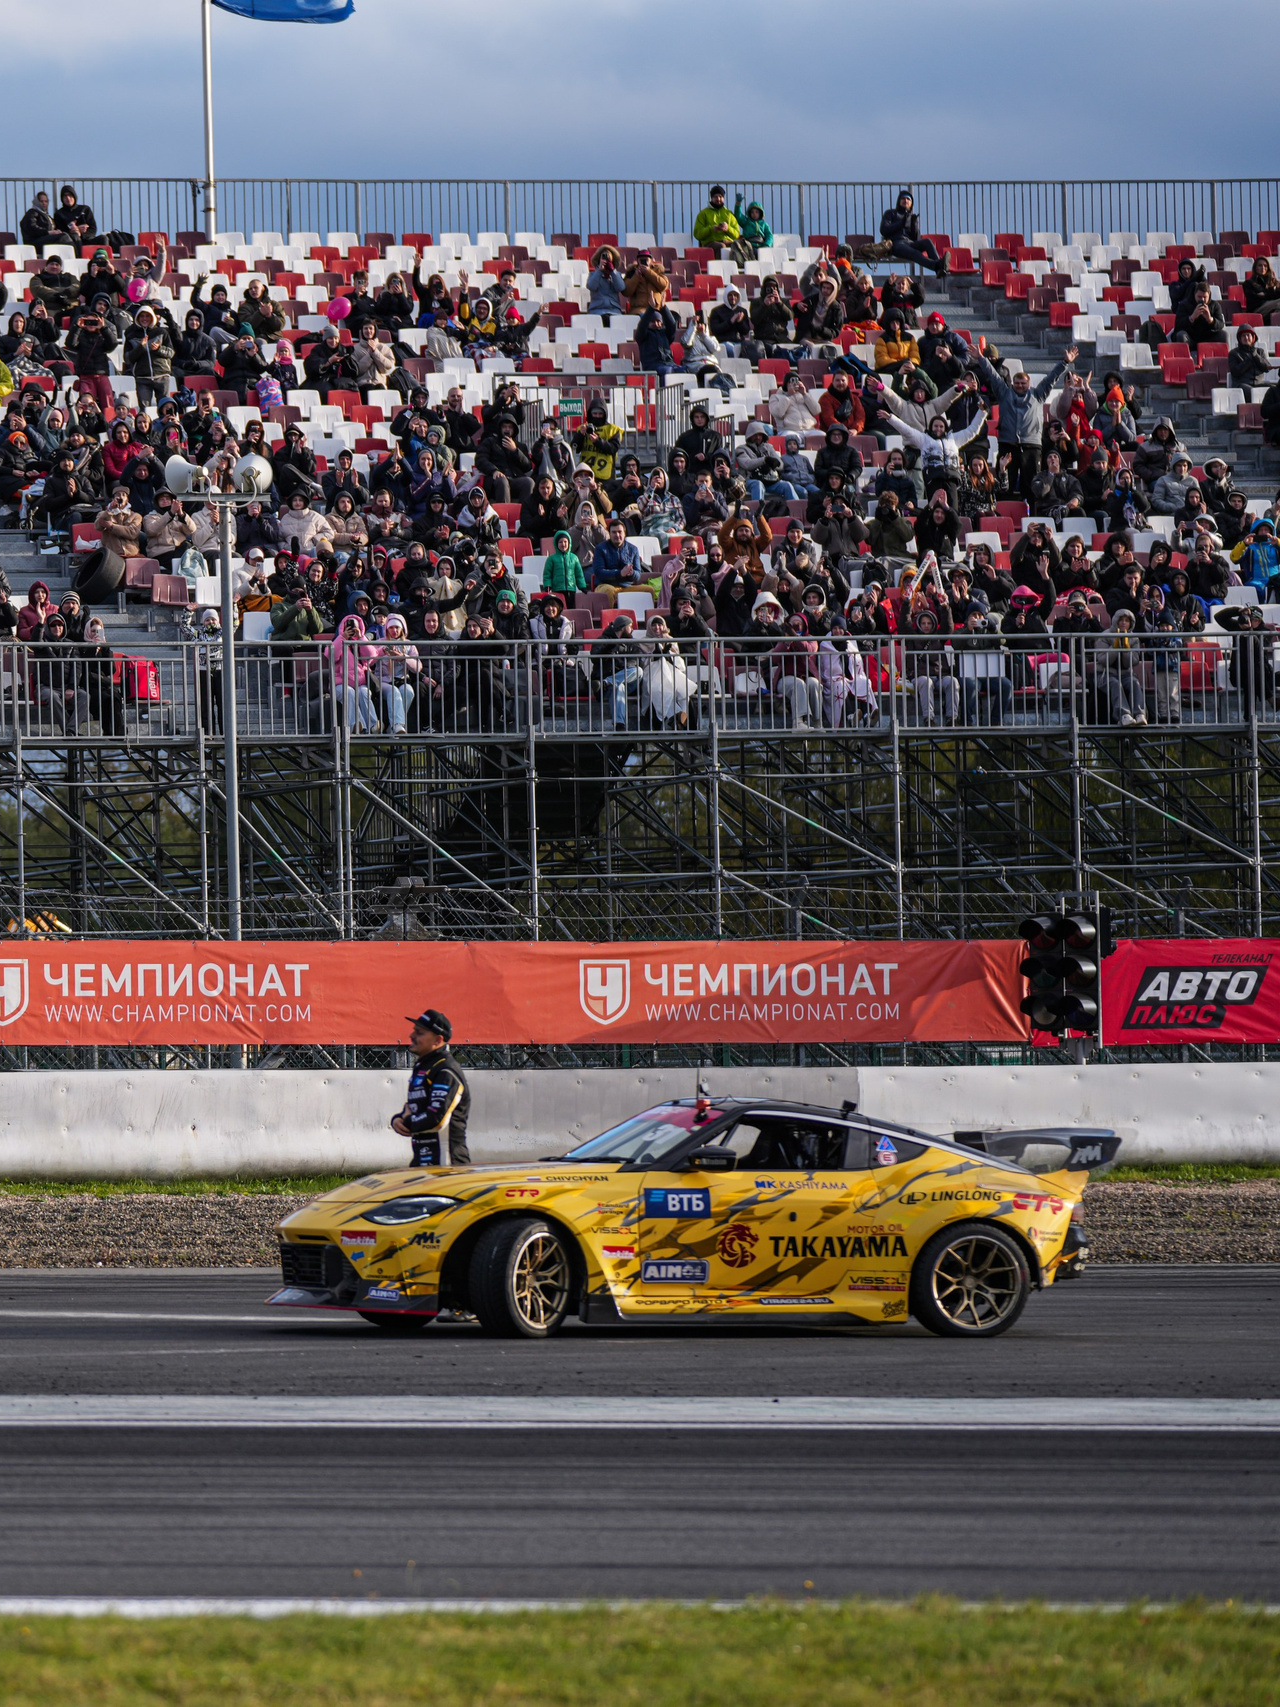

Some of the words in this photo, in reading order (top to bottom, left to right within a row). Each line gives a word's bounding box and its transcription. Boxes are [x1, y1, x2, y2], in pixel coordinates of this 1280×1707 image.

[560, 403, 582, 413] ВЫХОД
[1211, 953, 1274, 964] ТЕЛЕКАНАЛ
[44, 963, 310, 997] ЧЕМПИОНАТ
[644, 963, 899, 996] ЧЕМПИОНАТ
[1138, 970, 1259, 1002] АВТО
[44, 1004, 311, 1022] WWW.CHAMPIONAT.COM
[645, 1003, 900, 1021] WWW.CHAMPIONAT.COM
[1129, 1004, 1217, 1024] ПЛЮС
[505, 1189, 540, 1197] CTR
[779, 1181, 849, 1190] KASHIYAMA
[667, 1193, 705, 1212] ВТБ
[931, 1190, 1002, 1202] LINGLONG
[1012, 1193, 1065, 1215] CTR
[590, 1226, 637, 1235] VISSOL
[847, 1225, 885, 1234] MOTOR
[887, 1224, 905, 1232] OIL
[769, 1235, 909, 1258] TAKAYAMA
[645, 1265, 705, 1279] AIMOL
[849, 1276, 906, 1285] VISSOL
